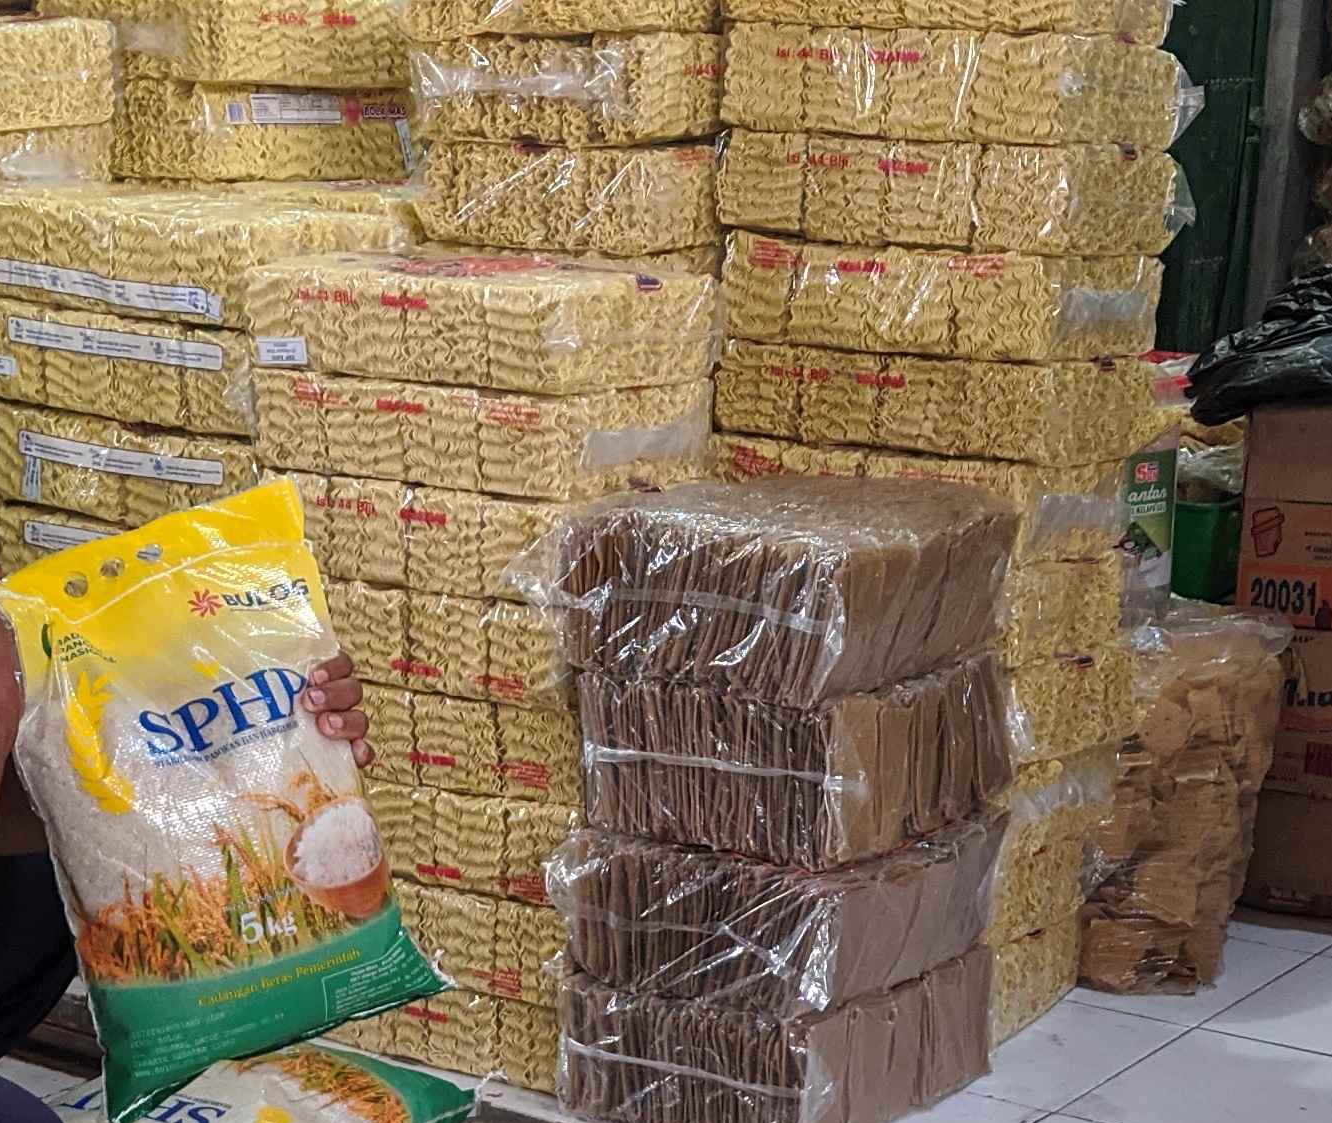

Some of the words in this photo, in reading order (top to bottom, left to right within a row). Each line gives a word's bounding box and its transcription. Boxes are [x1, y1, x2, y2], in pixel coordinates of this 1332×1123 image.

[1128, 484, 1167, 503] antan
[222, 579, 310, 608] BULOG
[1250, 576, 1318, 617] 20031
[138, 667, 308, 755] SPHP
[241, 910, 265, 944] 5
[267, 913, 298, 938] kg
